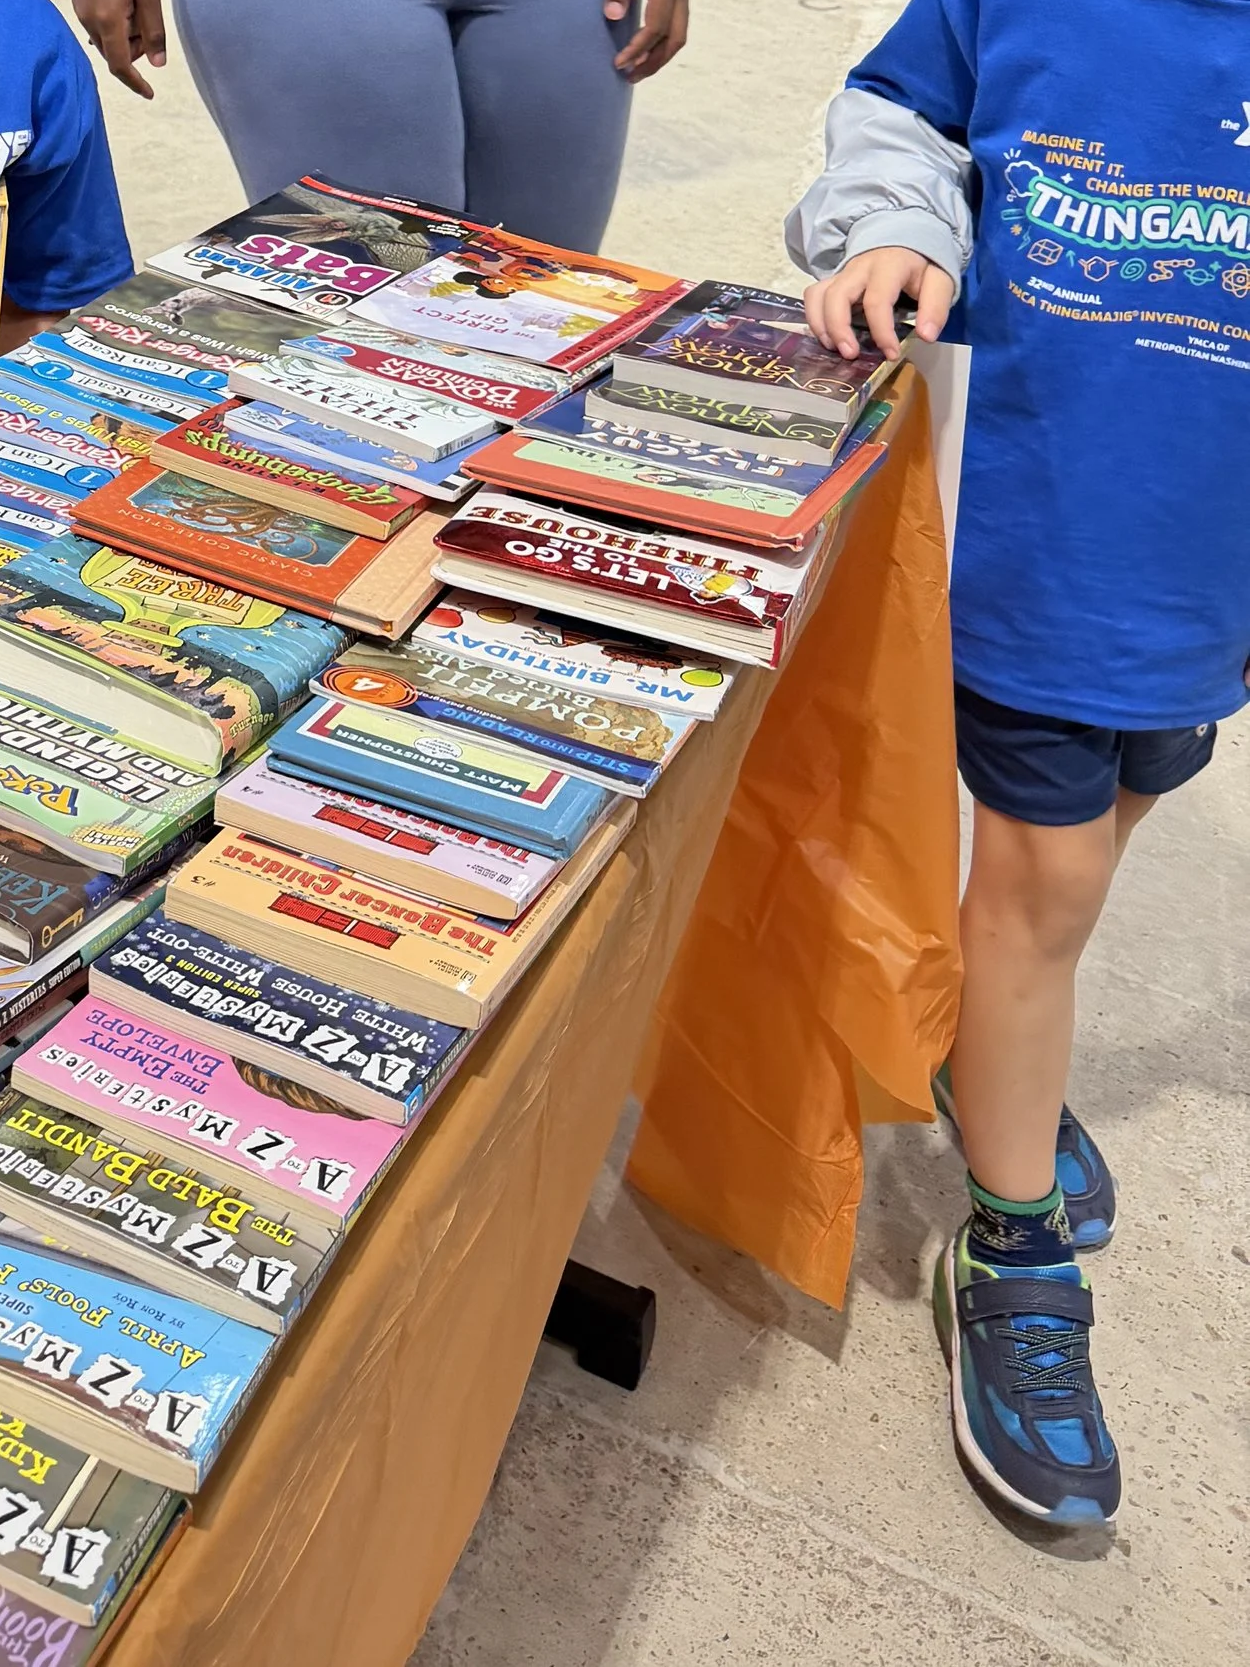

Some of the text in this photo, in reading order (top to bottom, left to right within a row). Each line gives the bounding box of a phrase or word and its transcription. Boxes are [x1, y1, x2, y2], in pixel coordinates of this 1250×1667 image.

[1021, 130, 1105, 156] IMAGINE IT.
[1221, 119, 1241, 131] the
[1046, 151, 1125, 178] INVENT IT.
[191, 246, 315, 292] All About
[240, 236, 394, 294] Bats
[412, 306, 510, 335] PERFECT
[455, 308, 509, 325] GIFT
[1053, 288, 1102, 305] ANNUAL
[77, 316, 241, 371] Ranger Rick
[1188, 335, 1230, 352] YMCA OF
[372, 360, 519, 404] BOXCAR
[381, 357, 489, 388] CHILDREN
[260, 375, 418, 431] STUART
[29, 427, 132, 469] Ranger
[177, 431, 399, 507] Goosebumps
[115, 508, 314, 579] CLASSIC COLLECTION
[464, 504, 763, 583] FIREHOUSE
[504, 540, 671, 590] LET'S GO
[546, 538, 639, 567] TO THE
[436, 630, 695, 703] MR. BIRTHDAY
[330, 727, 523, 796] MATT CHRISTOPHER
[436, 704, 633, 775] STEP INTO READING
[124, 746, 206, 789] AND
[218, 845, 498, 958] The Boxcar Children
[146, 925, 429, 1053] WHITE HOUSE WHITE-OUT
[79, 1030, 211, 1096] THE EMPTY
[85, 1008, 225, 1080] ENVELOPE
[5, 1107, 297, 1247] THE BALD BANDIT
[16, 1277, 111, 1329] FOOLS'
[117, 1314, 206, 1370] APRIL
